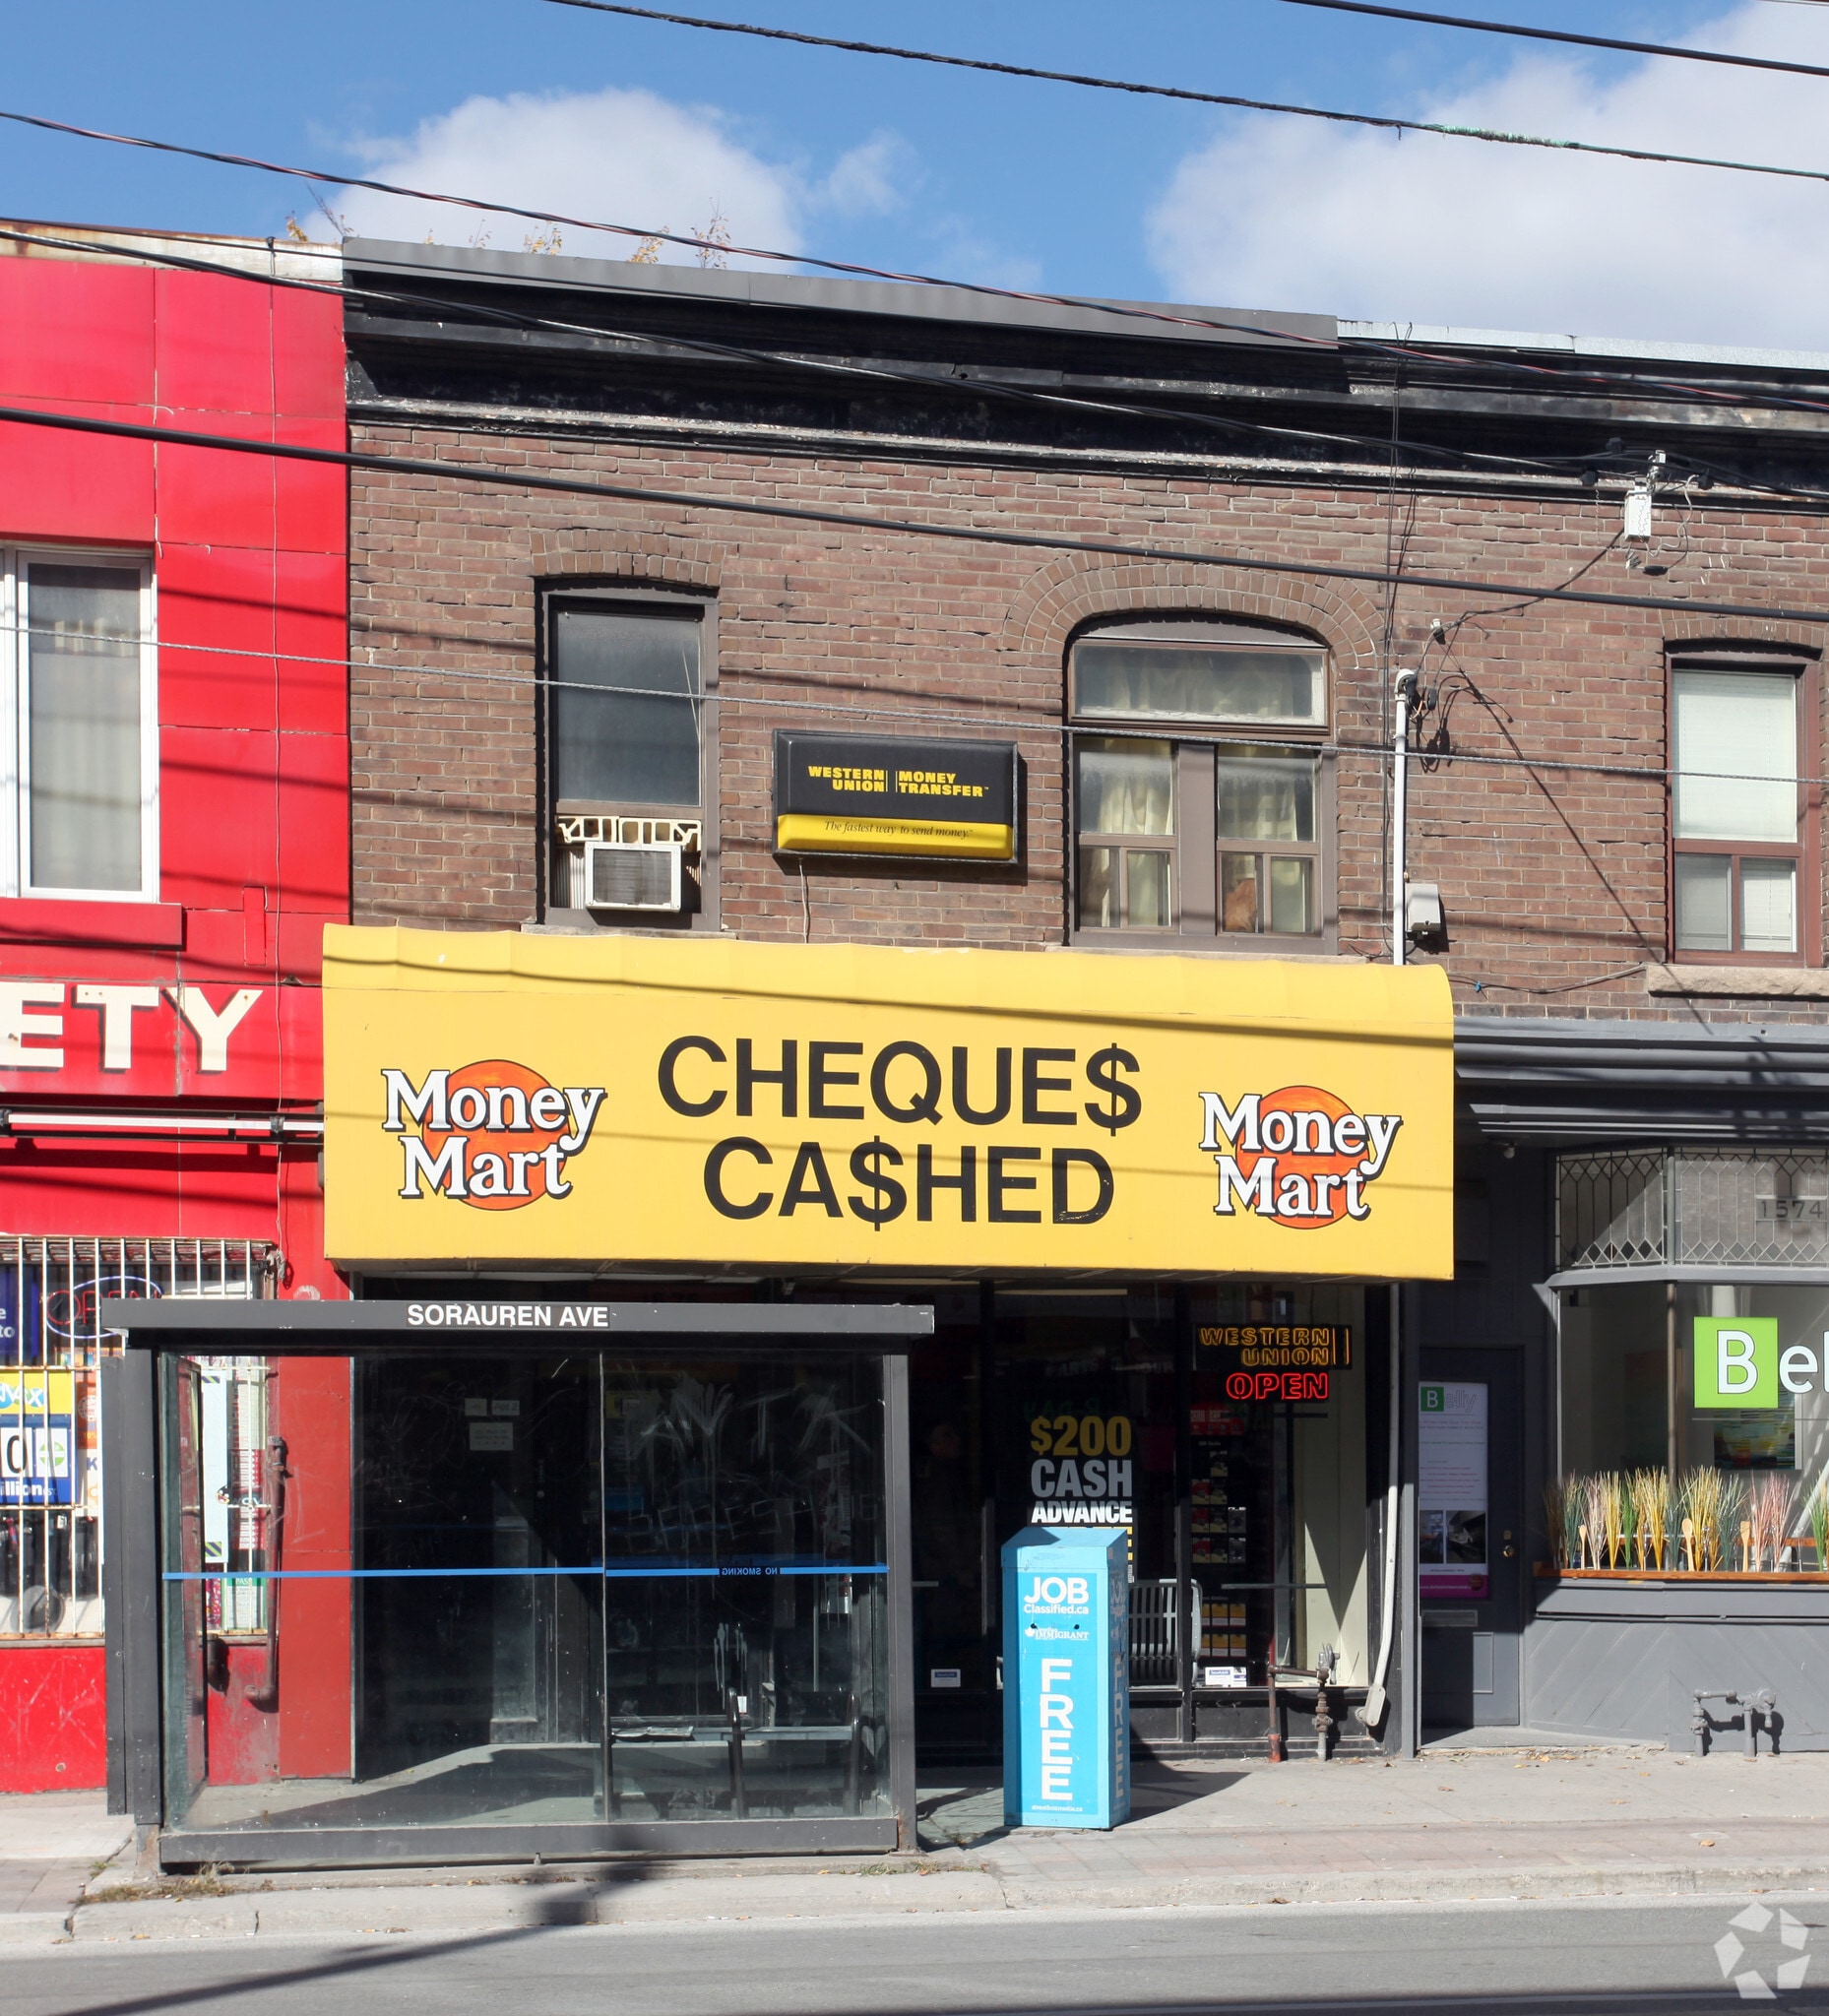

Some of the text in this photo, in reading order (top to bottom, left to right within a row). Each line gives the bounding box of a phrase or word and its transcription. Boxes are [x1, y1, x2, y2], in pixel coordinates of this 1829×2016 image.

[807, 766, 885, 781] WESTERN
[898, 771, 957, 784] MONEY
[832, 780, 885, 792] UNION
[898, 783, 983, 797] TRANSFER
[825, 821, 842, 832] The
[842, 822, 873, 834] fastest
[875, 825, 897, 837] way
[900, 825, 910, 835] to
[912, 827, 934, 837] send
[380, 1068, 608, 1157] Money
[1198, 1092, 1404, 1181] Money
[398, 1135, 574, 1200] Mart
[1213, 1155, 1372, 1222] Mart
[1760, 1199, 1824, 1220] 1574
[47, 1290, 158, 1325] OP
[408, 1304, 608, 1327] SORAUREN AVE
[1199, 1328, 1330, 1346] WESTERN
[1240, 1348, 1330, 1366] UNION
[1226, 1372, 1330, 1400] OPEN
[1426, 1389, 1477, 1413] Belly
[1030, 1416, 1132, 1456] $200
[1031, 1458, 1132, 1497] CASH
[1031, 1500, 1132, 1524] ADVANCE
[1024, 1576, 1090, 1605] JOB
[1024, 1604, 1090, 1614] Classified.ca
[1035, 1629, 1090, 1639] IMMIGRANT
[1040, 1658, 1075, 1800] FREE
